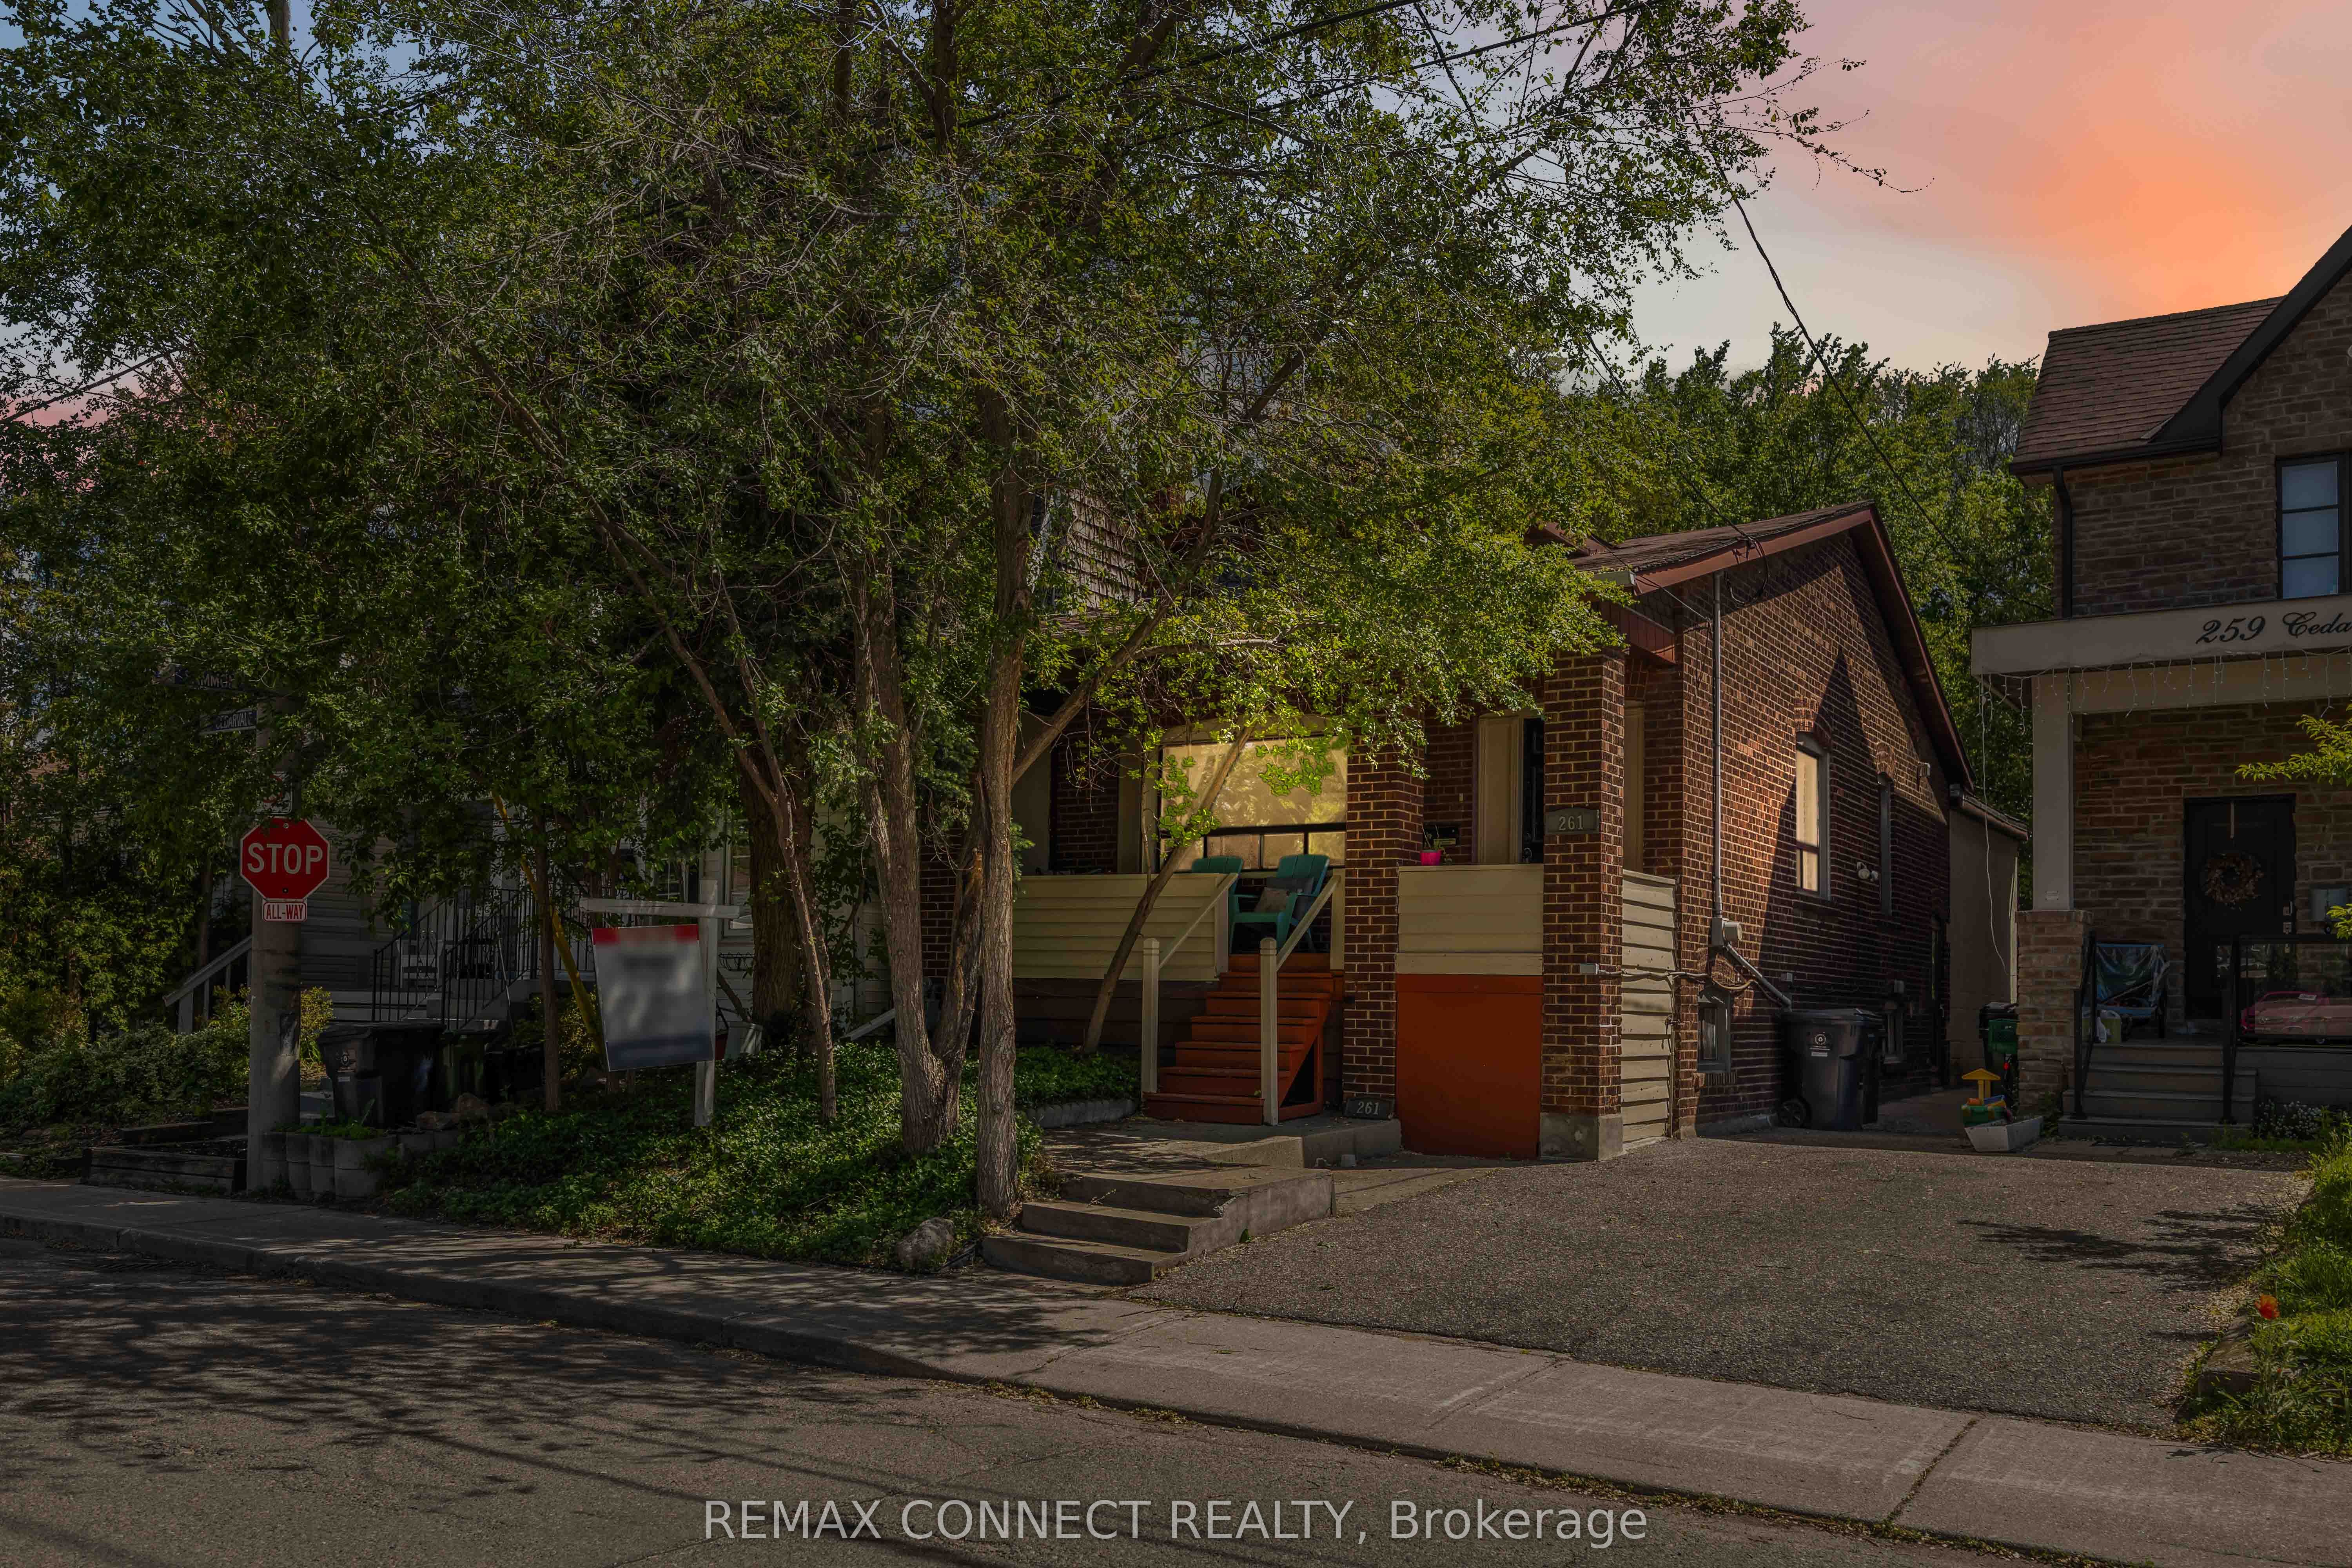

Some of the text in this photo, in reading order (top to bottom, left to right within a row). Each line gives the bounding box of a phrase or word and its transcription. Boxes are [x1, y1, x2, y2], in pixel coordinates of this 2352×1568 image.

[2196, 616, 2266, 644] 259
[1558, 815, 1584, 831] 261
[247, 842, 323, 875] STOP
[266, 904, 304, 920] ALL-WAY
[1356, 1100, 1380, 1116] 261
